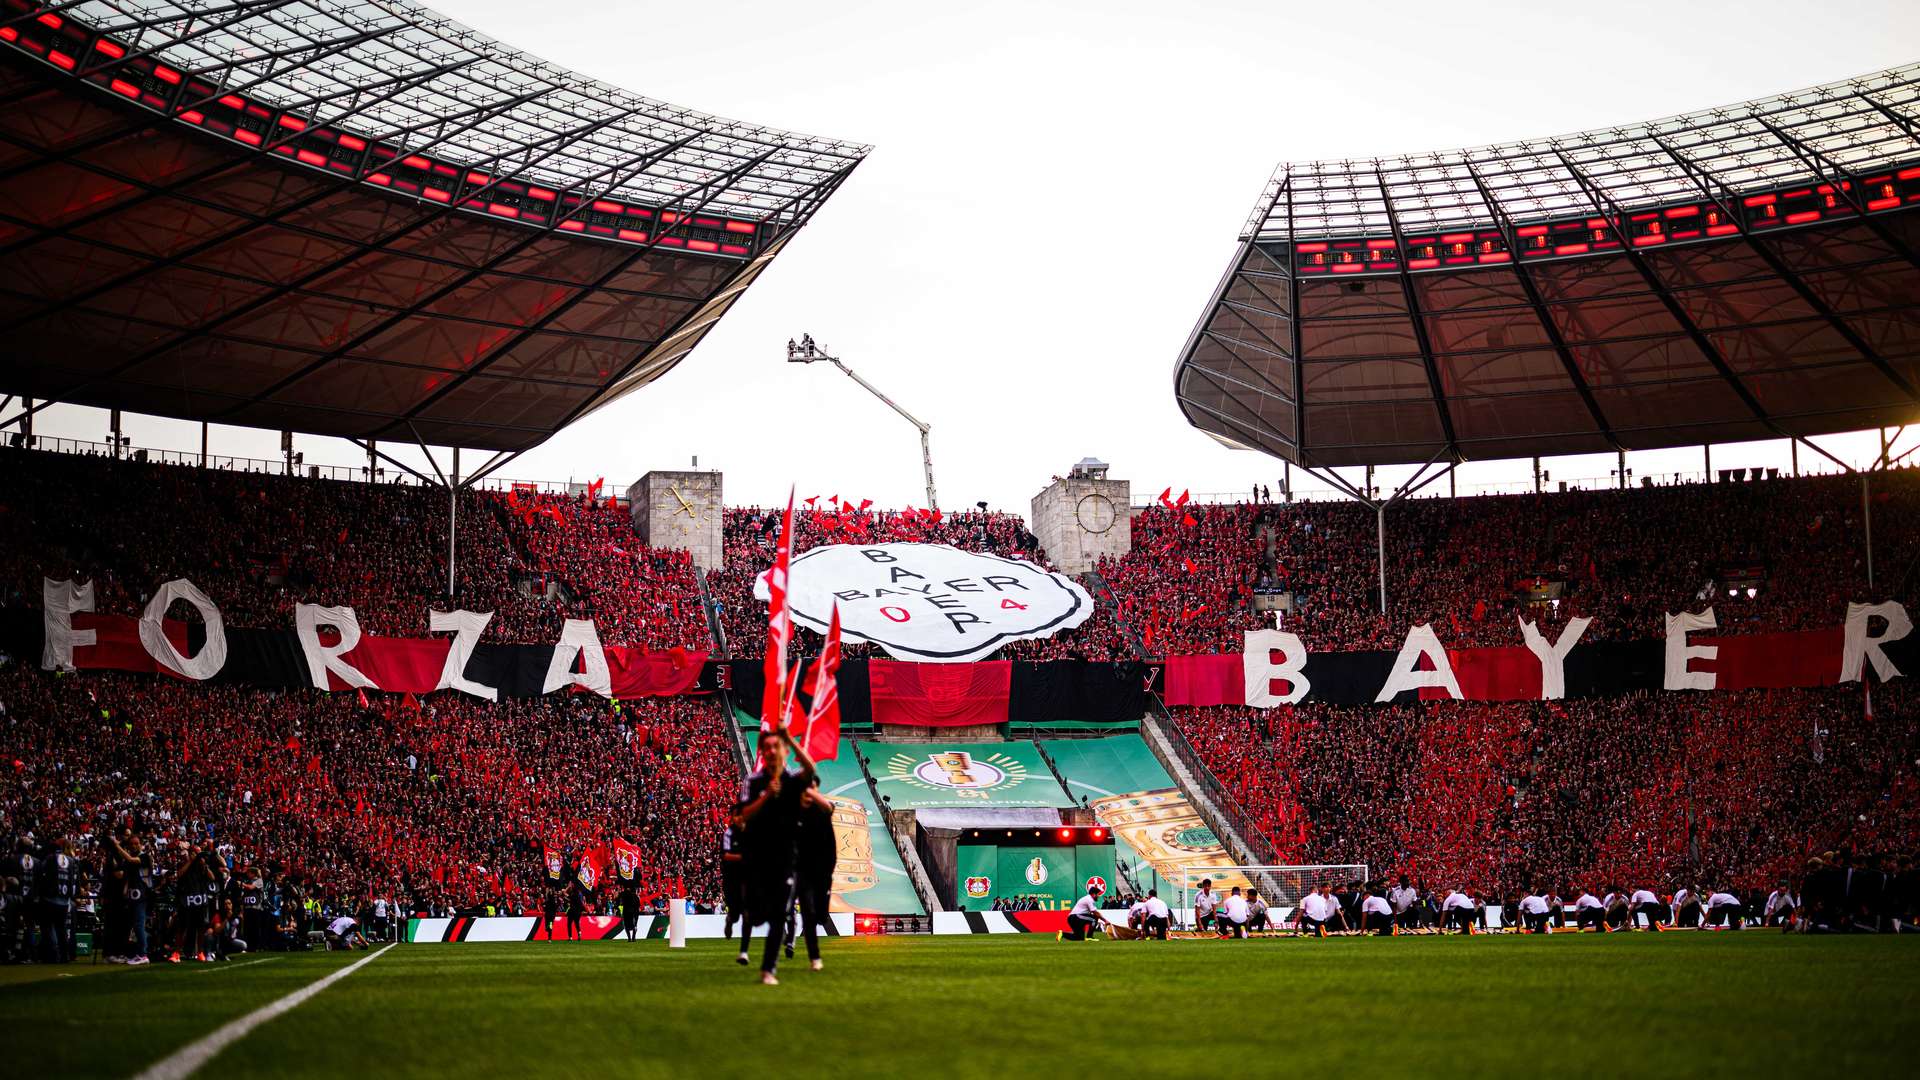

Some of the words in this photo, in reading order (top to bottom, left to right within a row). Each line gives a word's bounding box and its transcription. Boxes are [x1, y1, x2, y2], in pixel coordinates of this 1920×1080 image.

[833, 575, 1030, 602] BAYER
[860, 549, 991, 634] BAYER
[41, 577, 613, 701] FORZA
[1244, 600, 1914, 709] BAYER
